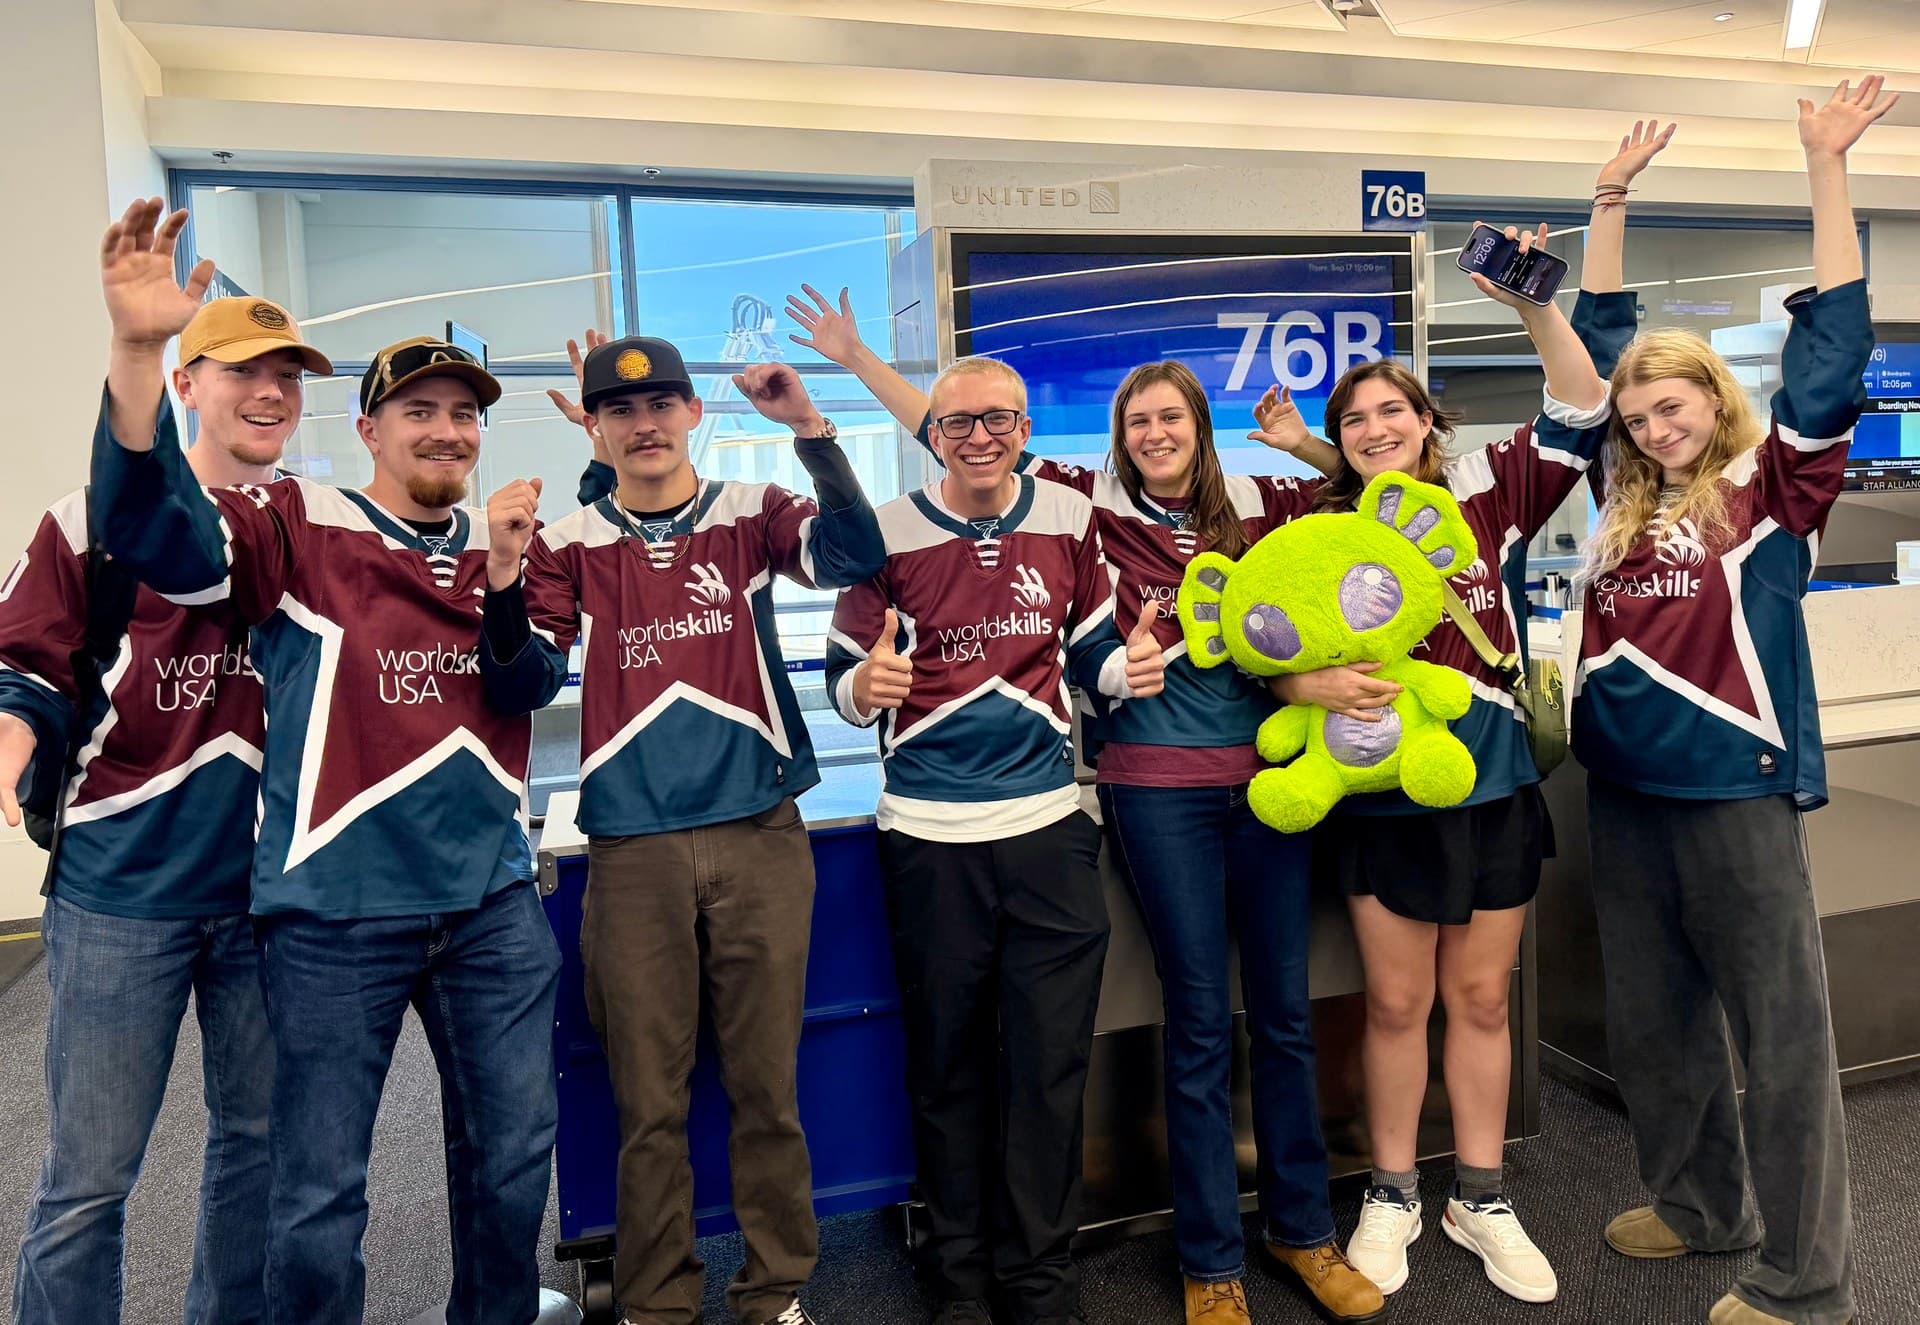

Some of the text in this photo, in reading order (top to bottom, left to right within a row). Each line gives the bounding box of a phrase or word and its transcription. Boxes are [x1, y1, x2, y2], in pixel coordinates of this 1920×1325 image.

[951, 184, 1081, 207] UNITED
[1366, 184, 1426, 218] 76B
[1473, 237, 1496, 265] 12:09
[1216, 309, 1383, 392] 76B
[1882, 379, 1912, 390] 12:05 pm
[1878, 401, 1908, 412] Boarding
[1863, 481, 1885, 491] STAR
[617, 608, 734, 646] worldskills
[938, 611, 1054, 643] worldskills
[618, 643, 663, 670] USA
[941, 641, 986, 663] USA
[156, 679, 217, 712] USA
[378, 673, 444, 705] USA
